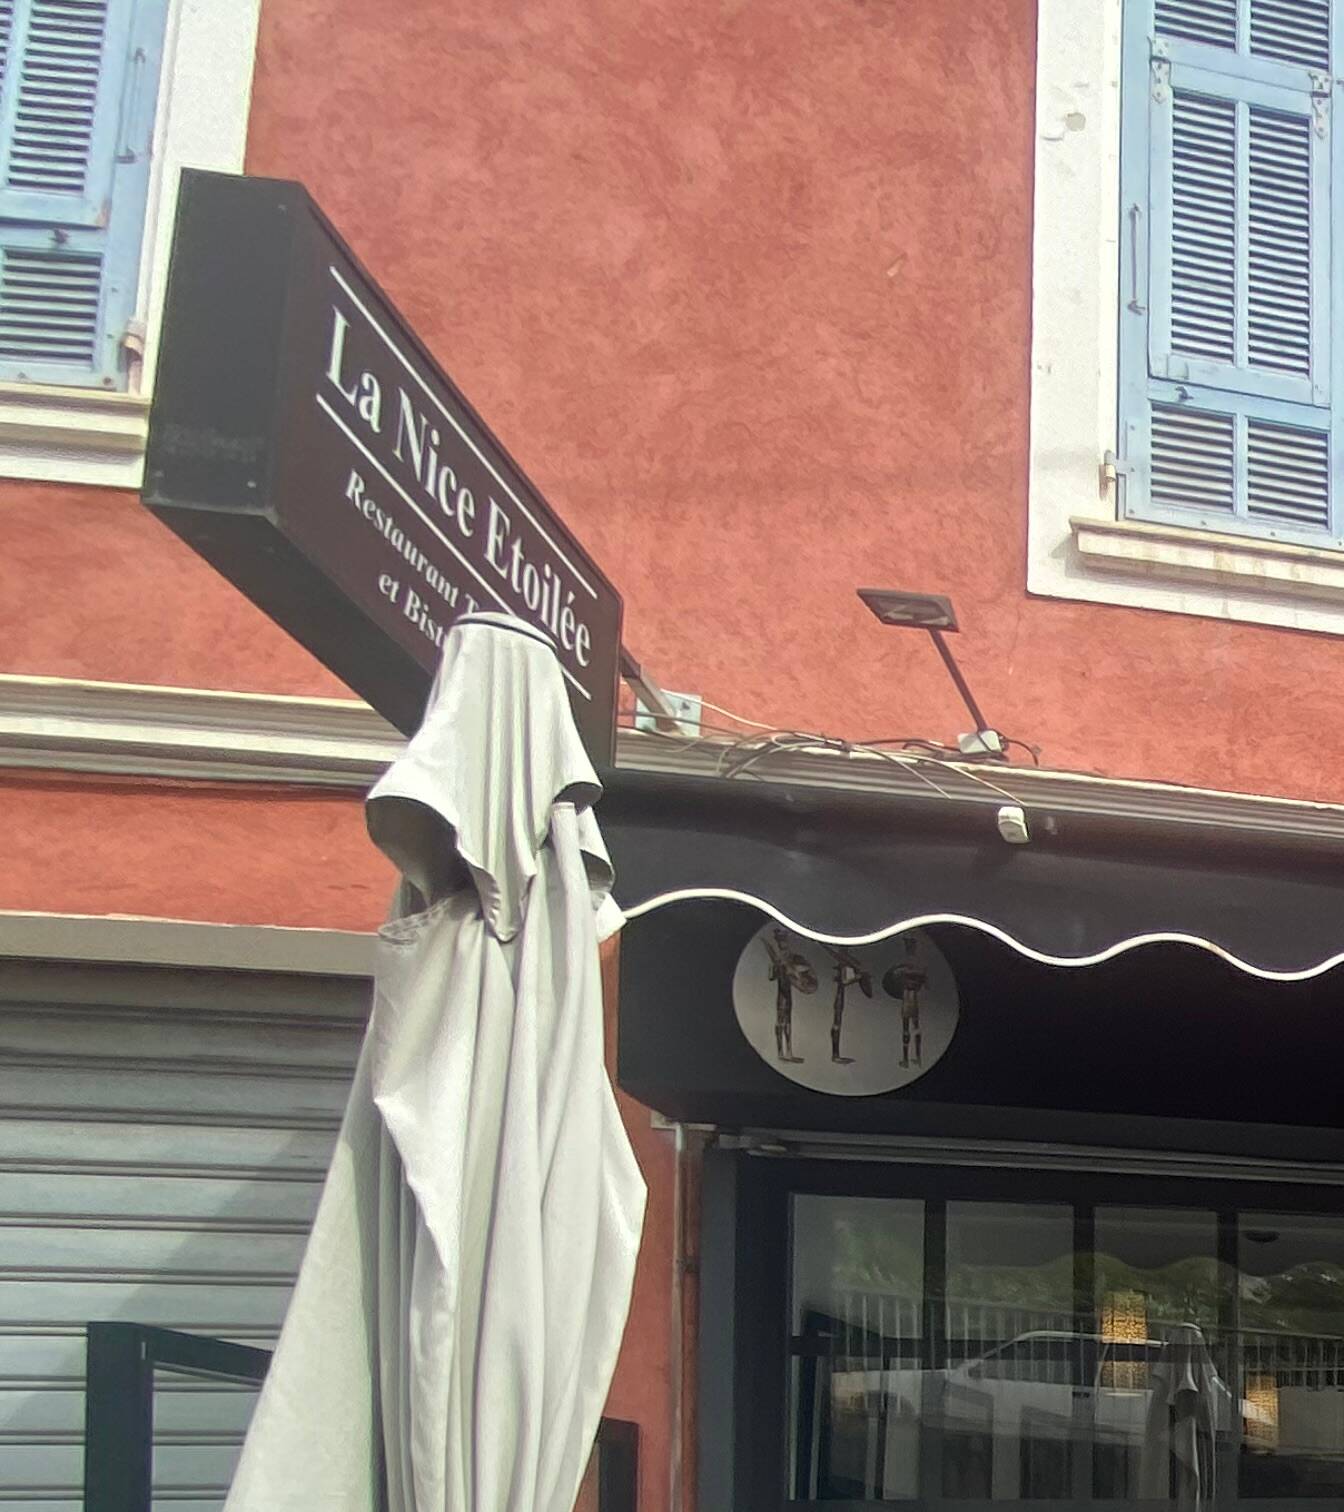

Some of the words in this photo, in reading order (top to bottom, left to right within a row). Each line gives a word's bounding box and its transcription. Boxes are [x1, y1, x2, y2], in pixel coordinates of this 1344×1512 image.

[326, 305, 381, 433] La
[392, 387, 475, 537] Nice
[484, 495, 592, 667] Etoilée
[345, 469, 460, 608] Restaurant
[378, 572, 400, 603] et
[403, 586, 447, 648] Bist
